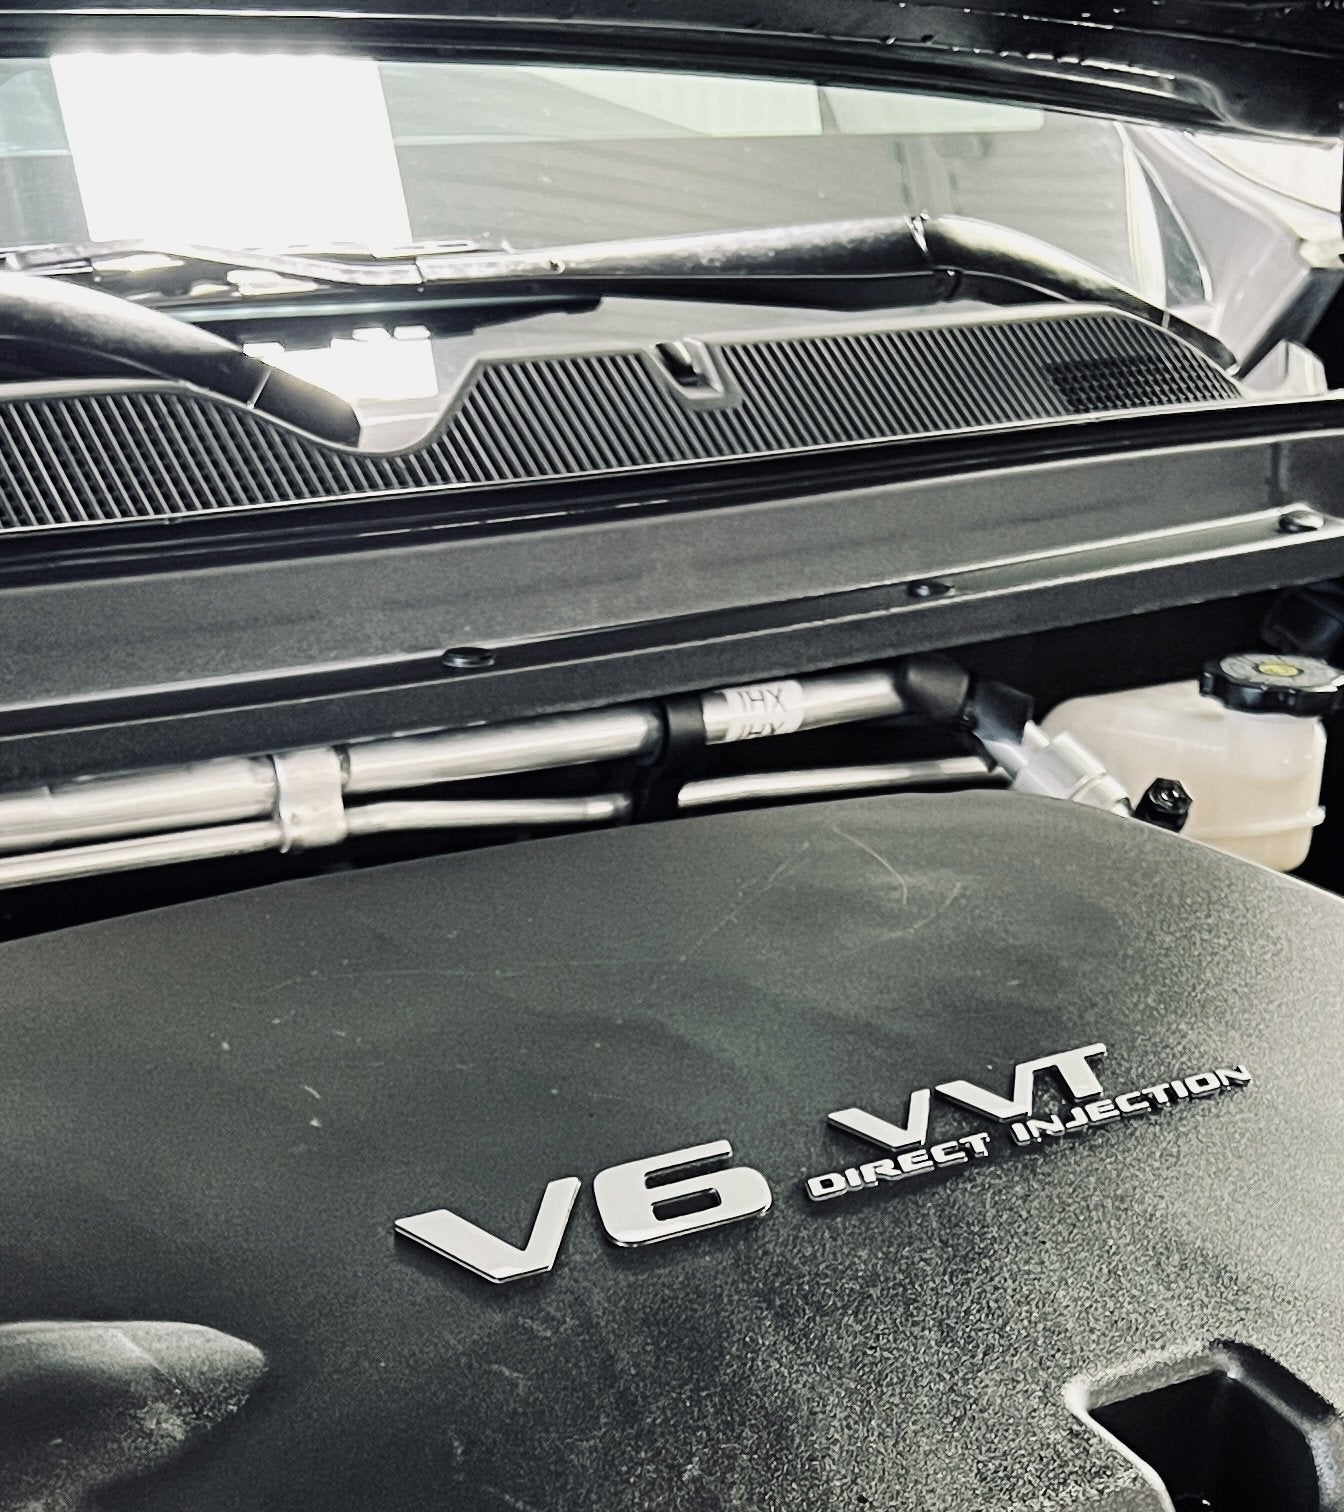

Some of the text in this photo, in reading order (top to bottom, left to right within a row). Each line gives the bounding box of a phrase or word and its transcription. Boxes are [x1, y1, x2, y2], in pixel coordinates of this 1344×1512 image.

[805, 1064, 1253, 1202] DIRECT INJECTION
[827, 1043, 1108, 1152] VVT
[394, 1138, 774, 1285] V6
